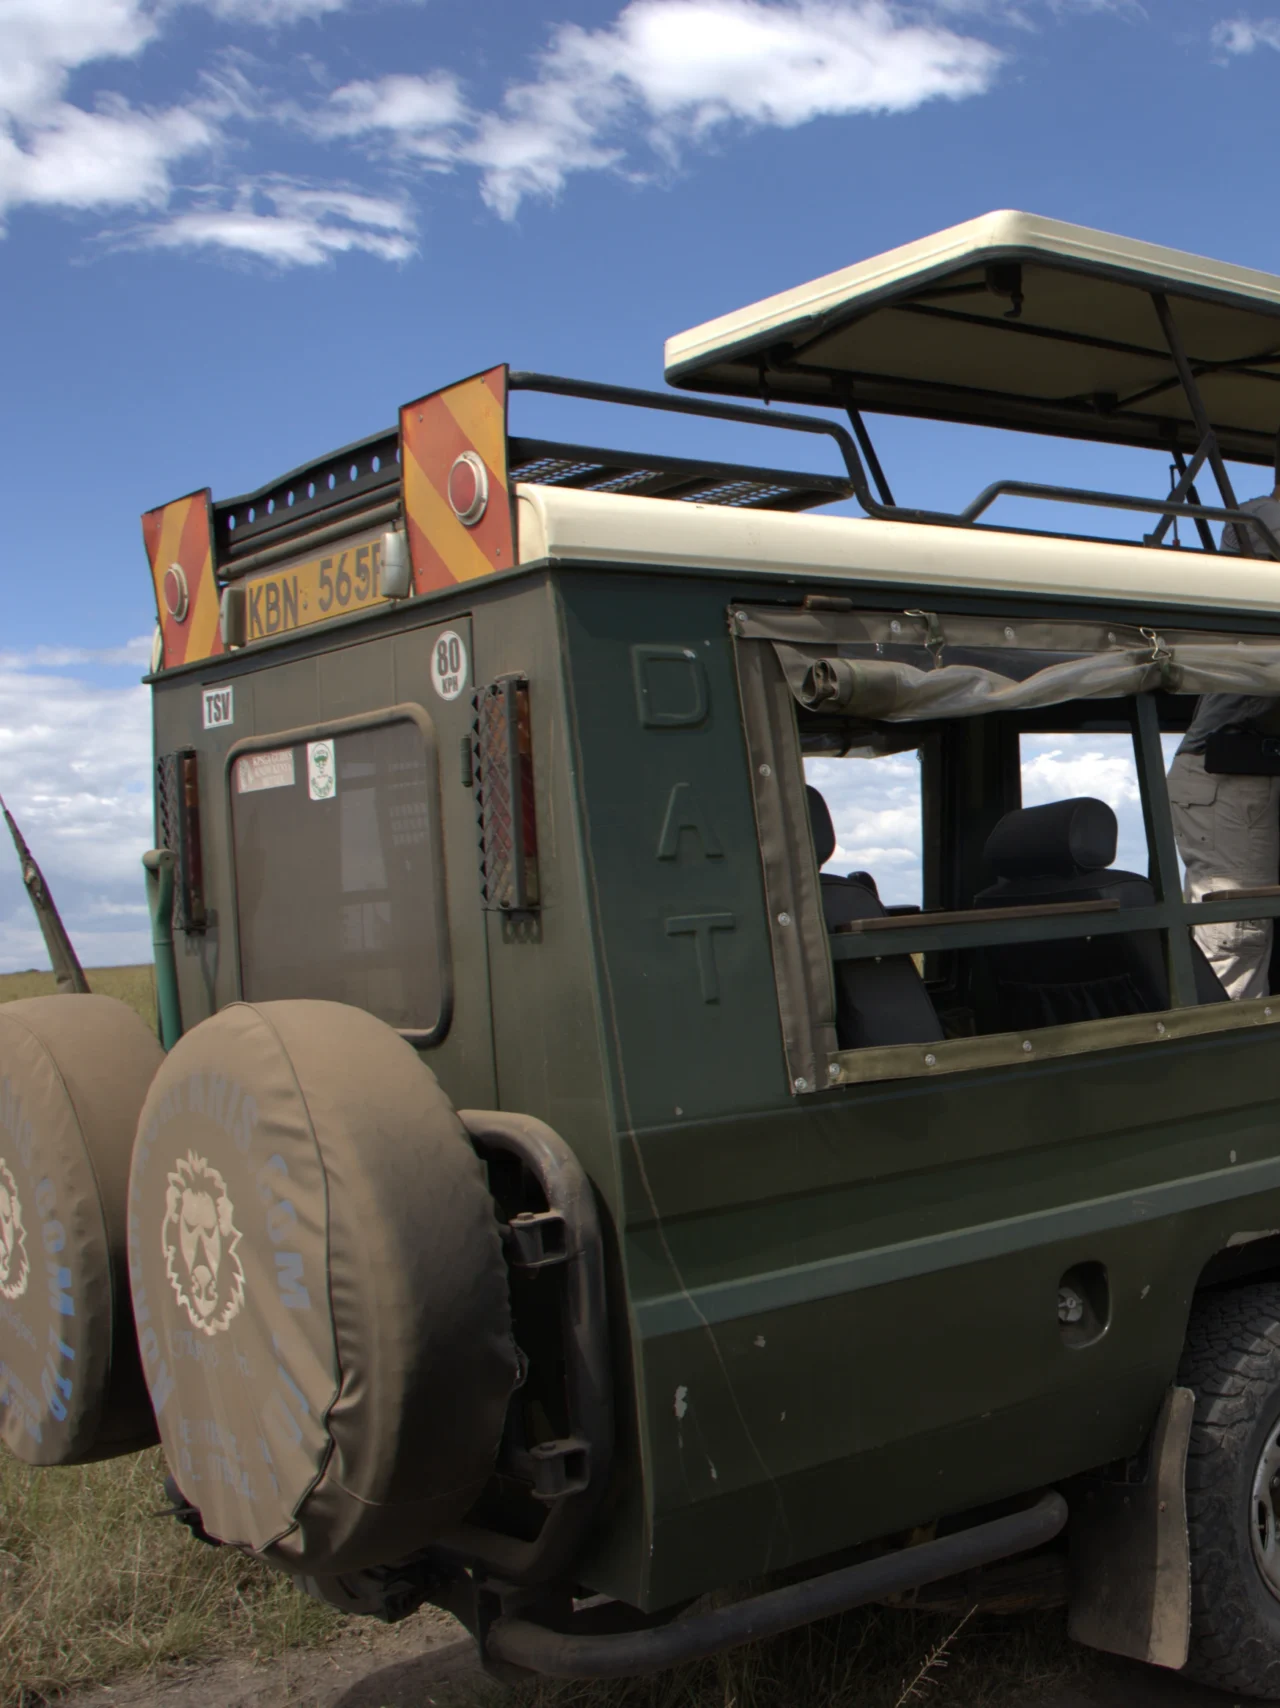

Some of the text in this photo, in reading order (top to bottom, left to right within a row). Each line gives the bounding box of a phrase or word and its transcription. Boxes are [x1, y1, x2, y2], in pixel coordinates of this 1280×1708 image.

[249, 576, 298, 637] KBN
[437, 637, 461, 677] 80
[442, 675, 459, 694] KPH
[206, 692, 230, 724] TSV
